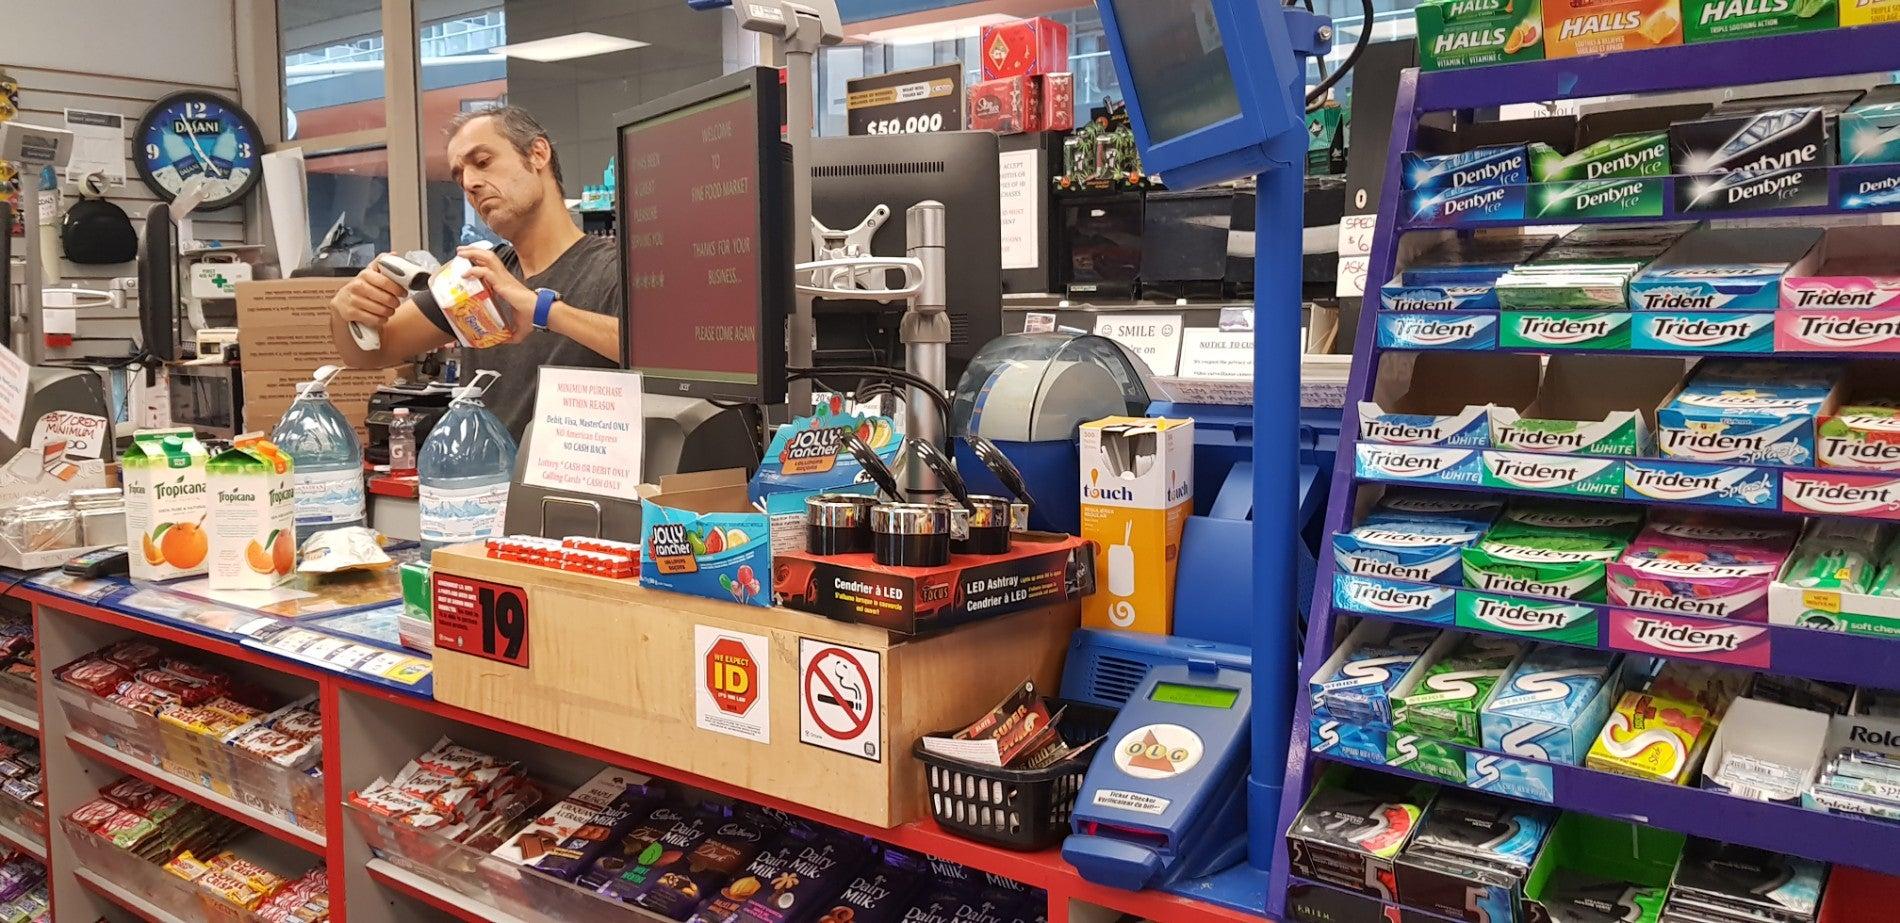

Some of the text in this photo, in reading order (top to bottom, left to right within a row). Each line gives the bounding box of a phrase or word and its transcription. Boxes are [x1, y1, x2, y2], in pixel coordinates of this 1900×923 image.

[1450, 0, 1499, 16] HALLS
[1700, 0, 1789, 24] HALLS
[1559, 10, 1641, 40] HALLS
[1758, 19, 1778, 28] ACTION
[1434, 28, 1506, 54] HALLS
[1437, 58, 1460, 68] VITAMIN
[1469, 55, 1497, 64] VITAMINE
[185, 102, 207, 119] 12
[175, 121, 219, 133] DASANI
[146, 144, 160, 160] 9
[238, 142, 251, 159] 3
[1587, 143, 1665, 179] Dentyne
[1640, 161, 1662, 176] Ice
[1453, 156, 1522, 188] Dentyne
[1500, 170, 1519, 185] Ice
[721, 177, 748, 197] MARKET
[1576, 181, 1643, 210] Dentyne
[1728, 172, 1802, 203] Dentyne
[1778, 187, 1799, 200] Ice
[1444, 188, 1505, 215] Dentyne
[1484, 201, 1501, 214] Ice
[1621, 195, 1639, 211] Ice
[693, 237, 751, 257] THANKS FOR YOUR
[1393, 299, 1455, 311] Trident
[1644, 294, 1715, 309] Trident
[1797, 290, 1876, 306] Trident
[695, 325, 755, 341] PLEASE COME AGAIN
[1118, 325, 1156, 337] SMILE
[1396, 319, 1475, 337] Trident
[1522, 318, 1607, 335] Trident
[1655, 318, 1751, 337] Trident
[1802, 317, 1900, 337] Trident
[1144, 346, 1156, 354] on
[1200, 341, 1227, 349] NOTICE
[558, 383, 624, 397] MINIMUM PURCHASE
[563, 397, 616, 411] WITHIN REASON
[613, 421, 630, 432] ONLY
[1364, 421, 1442, 440] Trident
[791, 427, 842, 448] JOLLY
[1448, 434, 1486, 446] WHITE
[1498, 427, 1585, 446] Trident
[1667, 429, 1764, 450] Trident
[564, 442, 572, 450] NO
[574, 443, 589, 452] CASH
[790, 444, 838, 459] rancher
[1591, 443, 1634, 455] WHITE
[1739, 437, 1803, 463] Splash
[563, 460, 580, 470] CASH
[1368, 450, 1442, 469] Trident
[1441, 470, 1480, 482] WHITE
[1494, 459, 1577, 481] Trident
[1635, 469, 1721, 489] Trident
[154, 481, 206, 499] Tropicana
[1084, 484, 1133, 501] touch
[1577, 481, 1619, 494] WHITE
[1719, 473, 1771, 498] Splash
[1795, 481, 1891, 502] Trident
[217, 490, 255, 503] Tropicana
[269, 487, 294, 506] Tropicana
[653, 526, 685, 545] JOLLY
[1363, 531, 1455, 545] Trident
[656, 542, 690, 557] rancher
[1494, 544, 1592, 561] Trident
[1351, 557, 1430, 580] Trident
[1639, 558, 1751, 576] Trident
[835, 578, 903, 600] Cendrier à LED
[967, 581, 984, 594] LED
[986, 575, 1020, 590] Ashtray
[1482, 572, 1570, 598] Trident
[967, 597, 1002, 612] Cendrier
[1004, 592, 1009, 603] à
[1011, 589, 1027, 602] LED
[1355, 583, 1432, 608] Trident
[1628, 589, 1728, 616] Trident
[1477, 599, 1567, 627] Trident
[479, 588, 524, 660] 19
[1851, 622, 1872, 631] soft
[1637, 619, 1740, 649] Trident
[714, 653, 749, 667] WE EXPECT
[714, 661, 749, 694] ID
[1325, 680, 1360, 689] STRIDE
[993, 704, 1028, 739] SUPER
[1129, 742, 1184, 761] OLG
[1130, 794, 1156, 803] Checker
[589, 812, 617, 827] Milk
[599, 805, 632, 820] Dairy
[660, 831, 690, 848] Milk
[671, 821, 704, 840] Dairy
[799, 846, 837, 870] Dairy
[746, 861, 777, 879] Milk
[789, 858, 821, 879] Milk
[931, 862, 968, 880] Milk
[849, 877, 890, 900] Dairy
[986, 872, 1025, 892] Milk
[840, 888, 876, 910] Milk
[906, 906, 948, 923] Dairy
[956, 904, 1001, 923] Dairy
